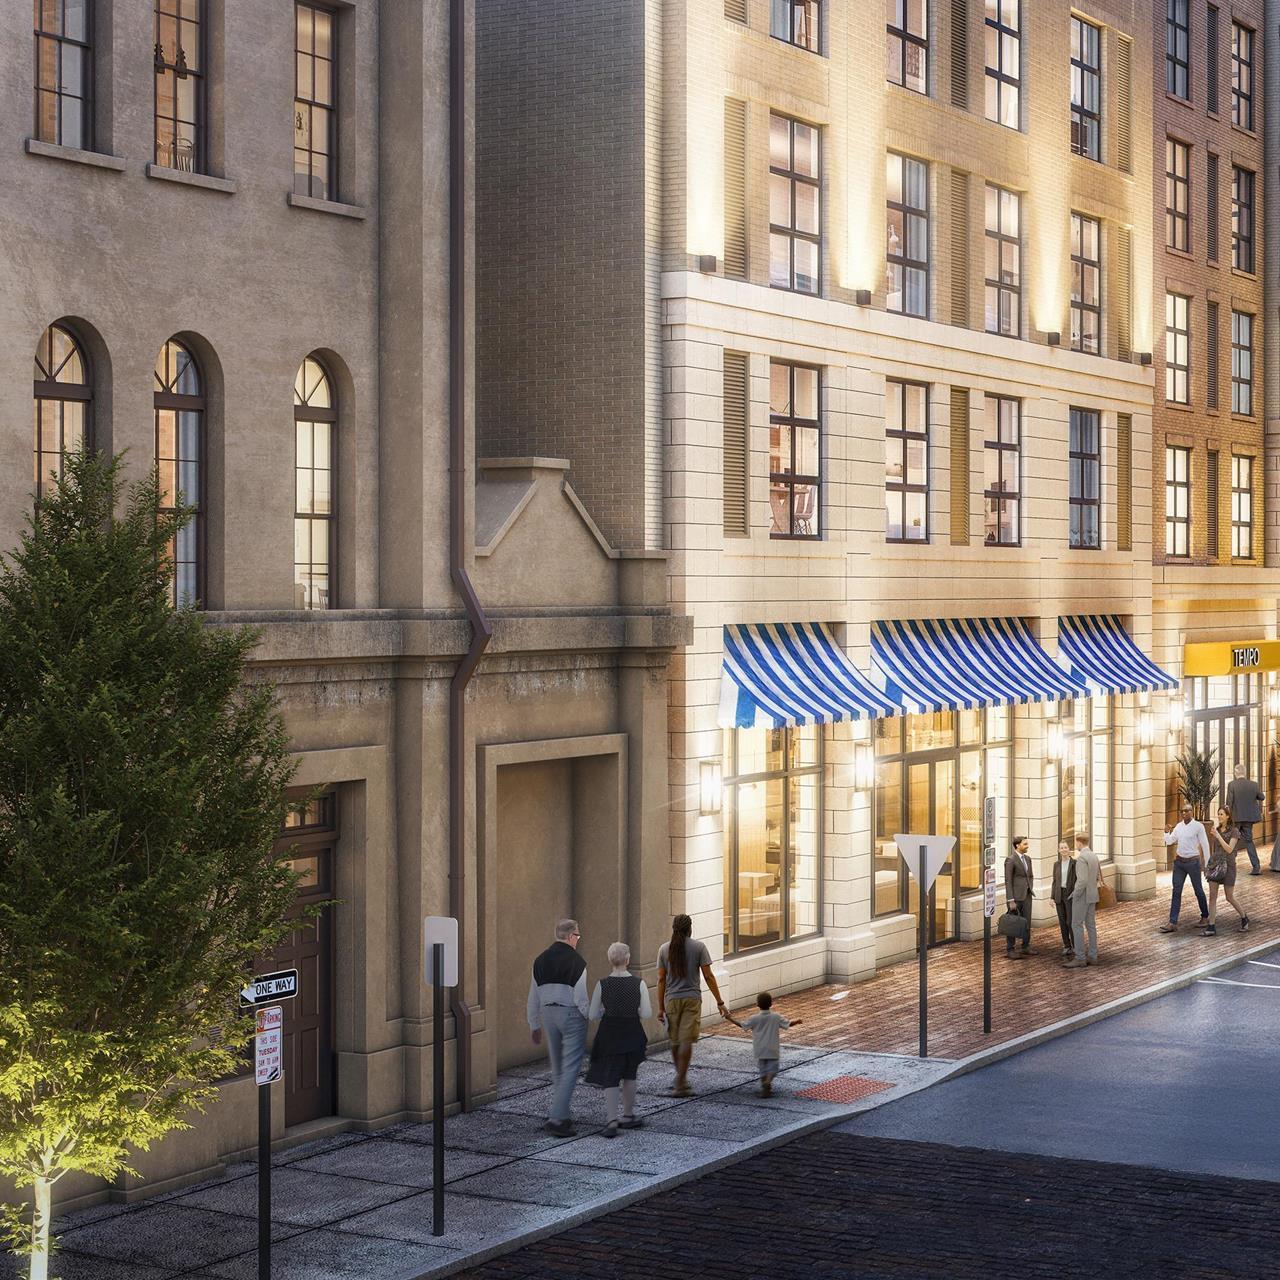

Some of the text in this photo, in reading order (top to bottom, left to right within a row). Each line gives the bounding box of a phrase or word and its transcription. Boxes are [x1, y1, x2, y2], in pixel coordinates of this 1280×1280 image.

[1232, 647, 1260, 667] TEMPO
[256, 978, 292, 995] ONE WAY
[258, 1047, 278, 1056] TUESDAY
